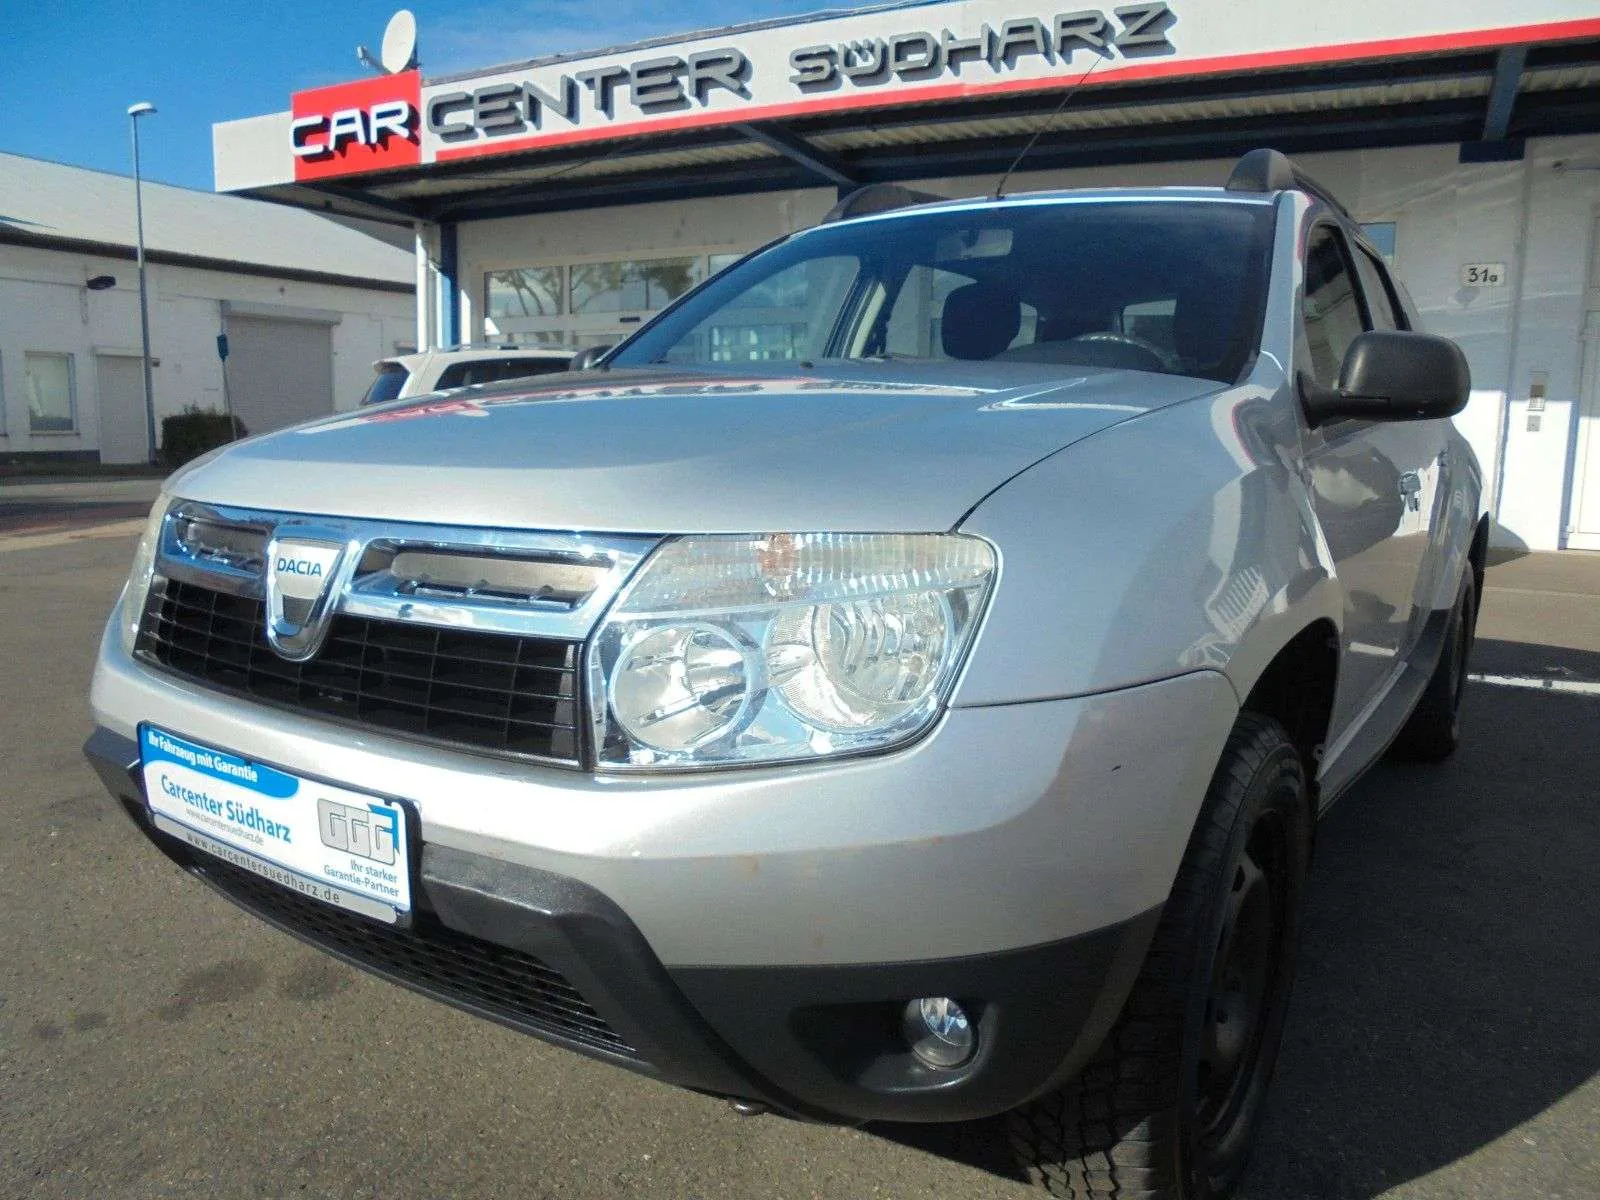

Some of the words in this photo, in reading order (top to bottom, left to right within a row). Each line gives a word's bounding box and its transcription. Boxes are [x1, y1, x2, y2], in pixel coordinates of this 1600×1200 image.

[289, 101, 416, 158] CAR
[427, 47, 751, 141] CENTER
[789, 1, 1174, 90] SÜDHARZ
[1468, 267, 1498, 283] 31a
[277, 558, 322, 577] DACIA
[148, 731, 159, 748] Ihr
[159, 735, 196, 766] Fahrzeug
[196, 753, 213, 769] mit
[213, 756, 258, 782] Garantie
[161, 774, 223, 816] Carcenter
[226, 800, 292, 844] Südharz
[186, 832, 340, 903] www.carcentersuedharz.de
[324, 865, 399, 897] Garantie-Partner
[350, 859, 363, 873] Ihr
[365, 865, 398, 883] starker
